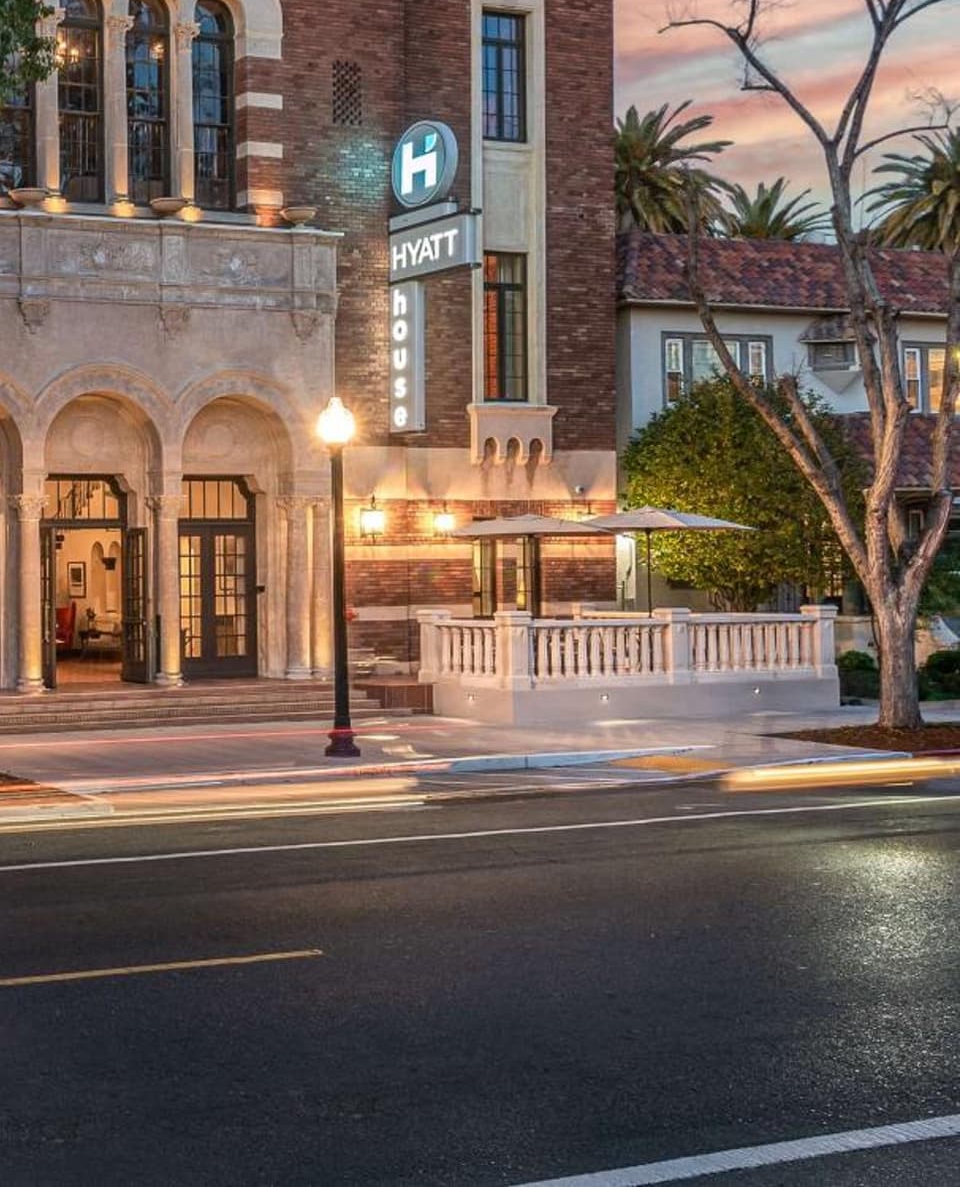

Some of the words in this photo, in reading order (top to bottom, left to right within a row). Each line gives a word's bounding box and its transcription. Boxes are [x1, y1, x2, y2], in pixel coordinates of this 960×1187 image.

[401, 133, 437, 195] H
[392, 228, 458, 270] HYATT
[392, 288, 408, 427] house
